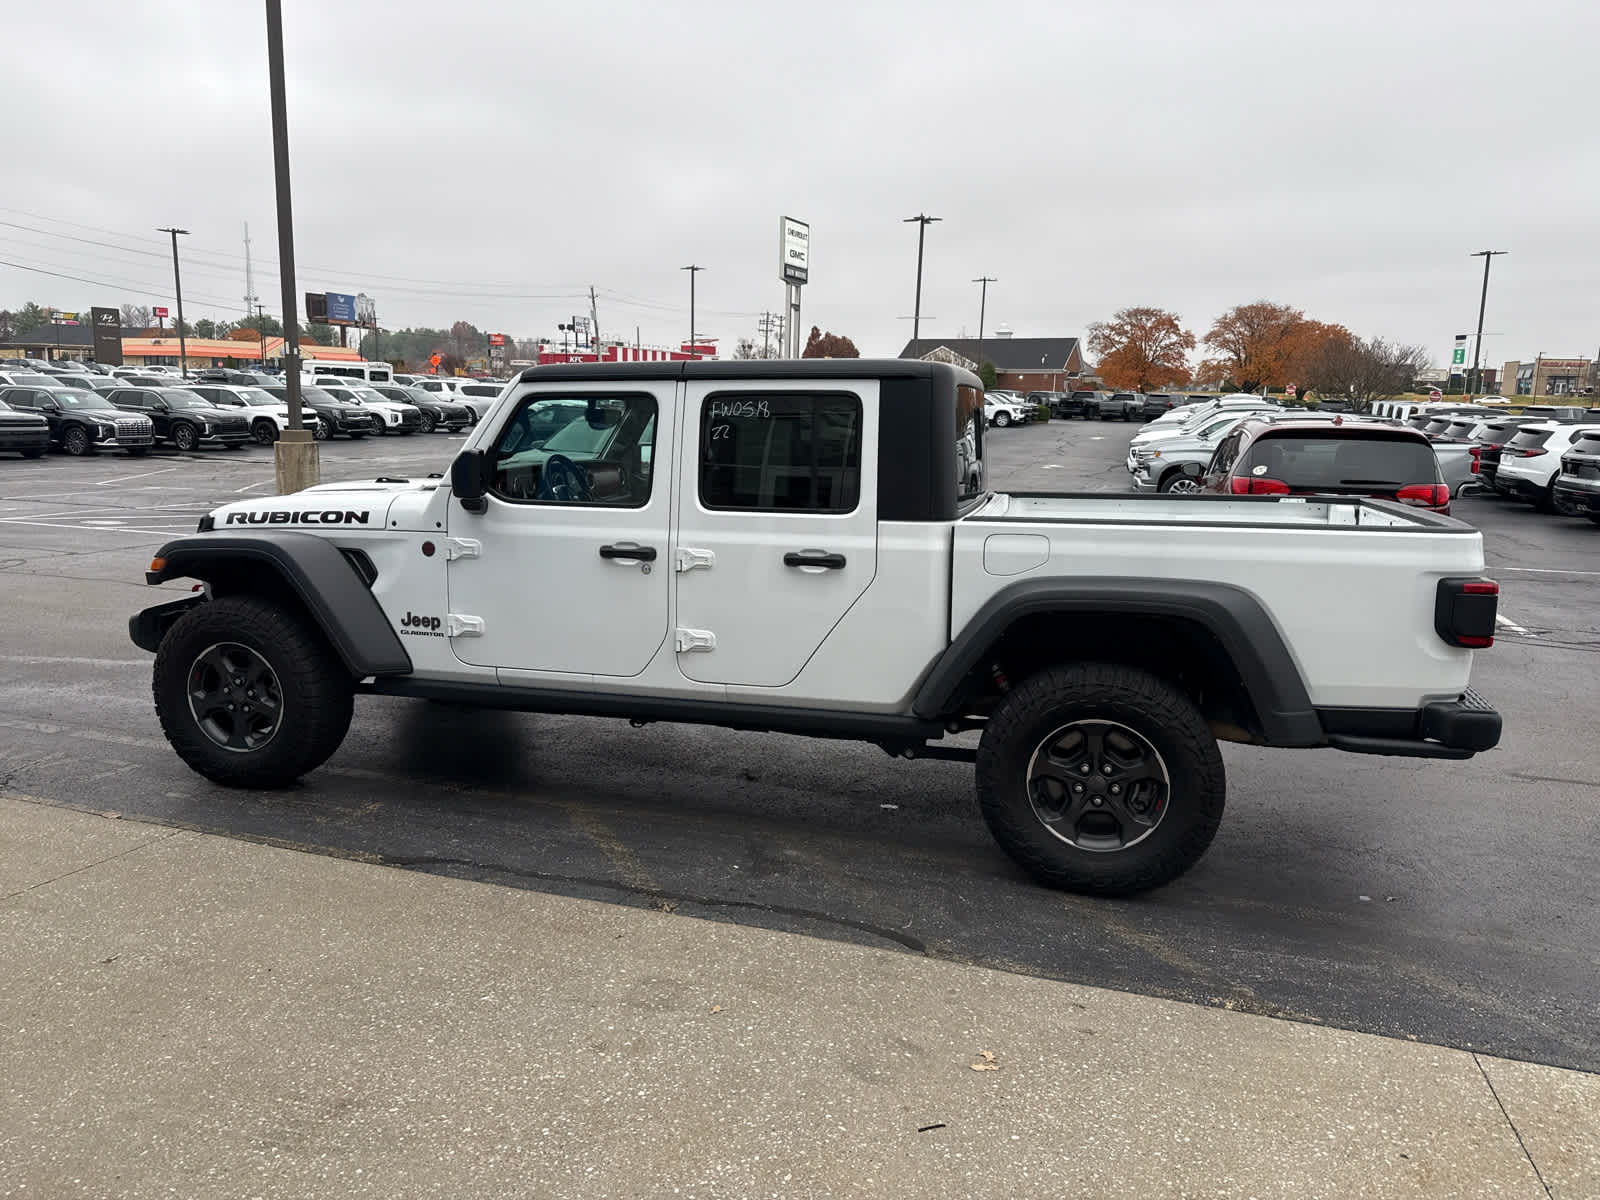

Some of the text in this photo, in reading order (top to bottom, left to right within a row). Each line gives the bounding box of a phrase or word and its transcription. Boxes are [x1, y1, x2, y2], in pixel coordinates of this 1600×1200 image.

[789, 249, 805, 261] GMC
[226, 511, 370, 525] RUBICON
[400, 611, 441, 631] Jeep
[400, 629, 445, 638] GLADIATOR
